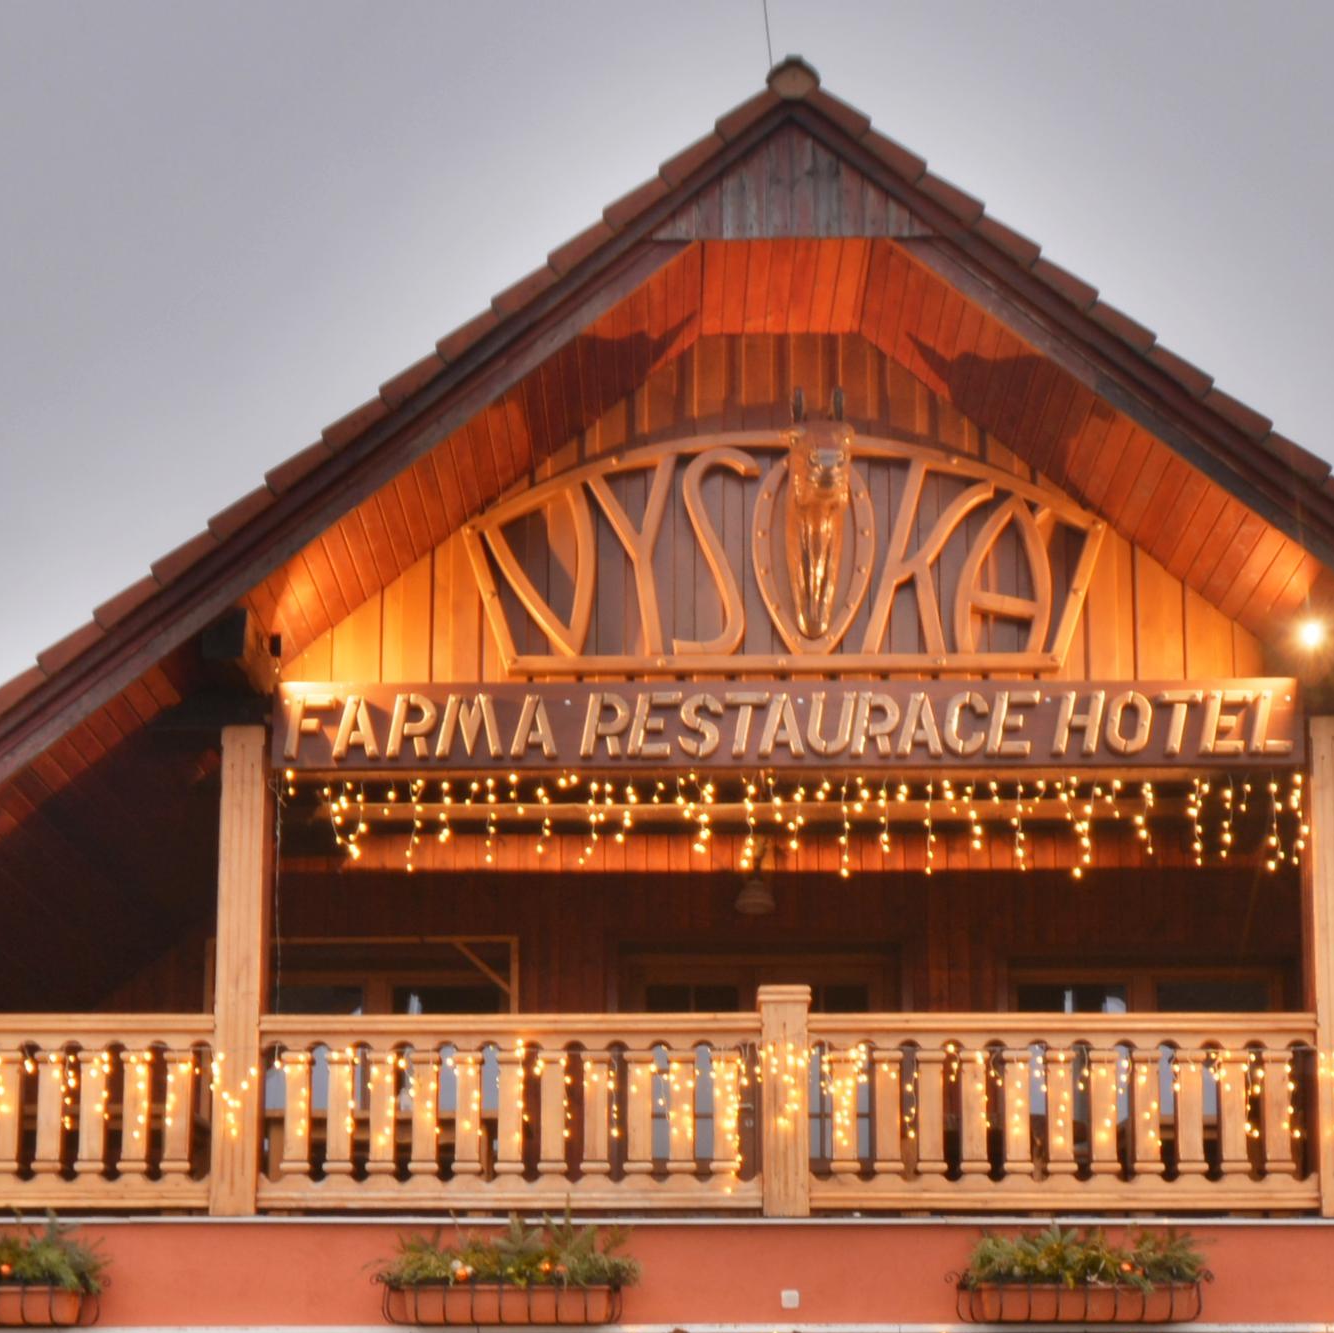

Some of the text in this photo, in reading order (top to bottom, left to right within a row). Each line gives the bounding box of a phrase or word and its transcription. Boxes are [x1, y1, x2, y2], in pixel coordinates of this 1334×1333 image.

[283, 689, 1294, 761] FARMA RESTAURACE HOTEL
